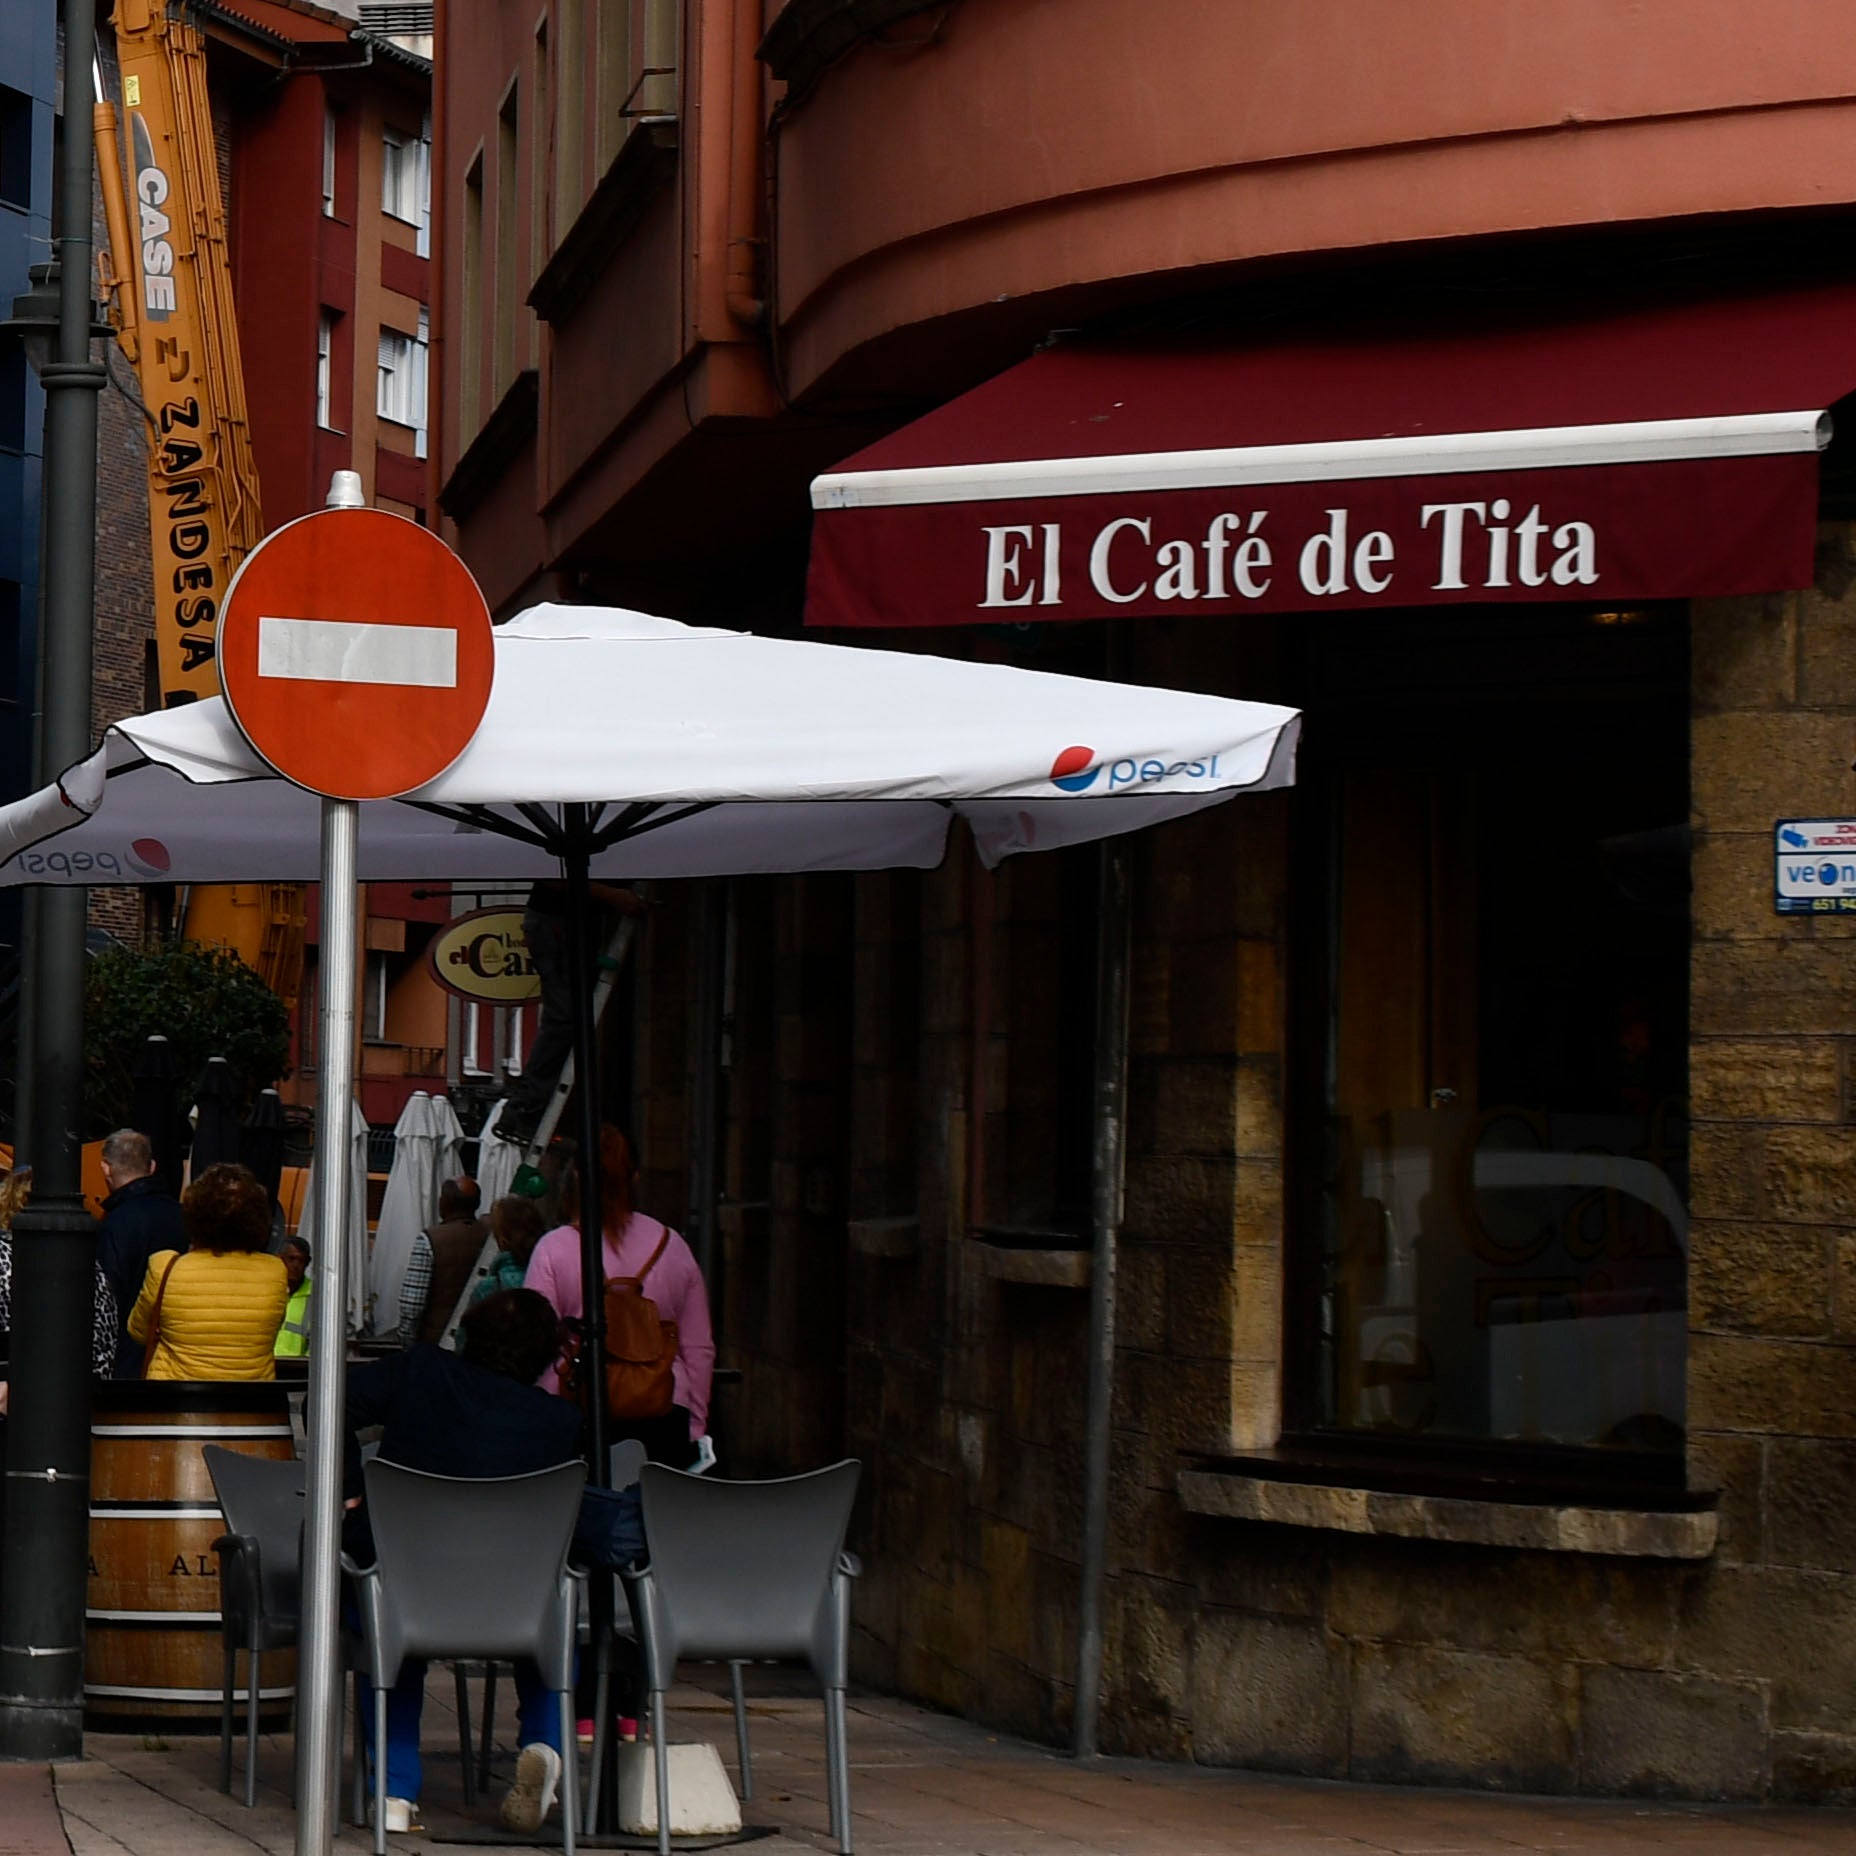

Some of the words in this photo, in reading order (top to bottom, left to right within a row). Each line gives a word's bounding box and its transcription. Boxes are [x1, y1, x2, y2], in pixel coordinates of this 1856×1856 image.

[137, 166, 177, 311] CASE
[160, 396, 216, 673] ZANDESA
[975, 523, 1064, 609] El
[1088, 510, 1273, 604] Café
[1298, 508, 1395, 596] de
[1420, 498, 1601, 591] Tita
[449, 946, 468, 965] el
